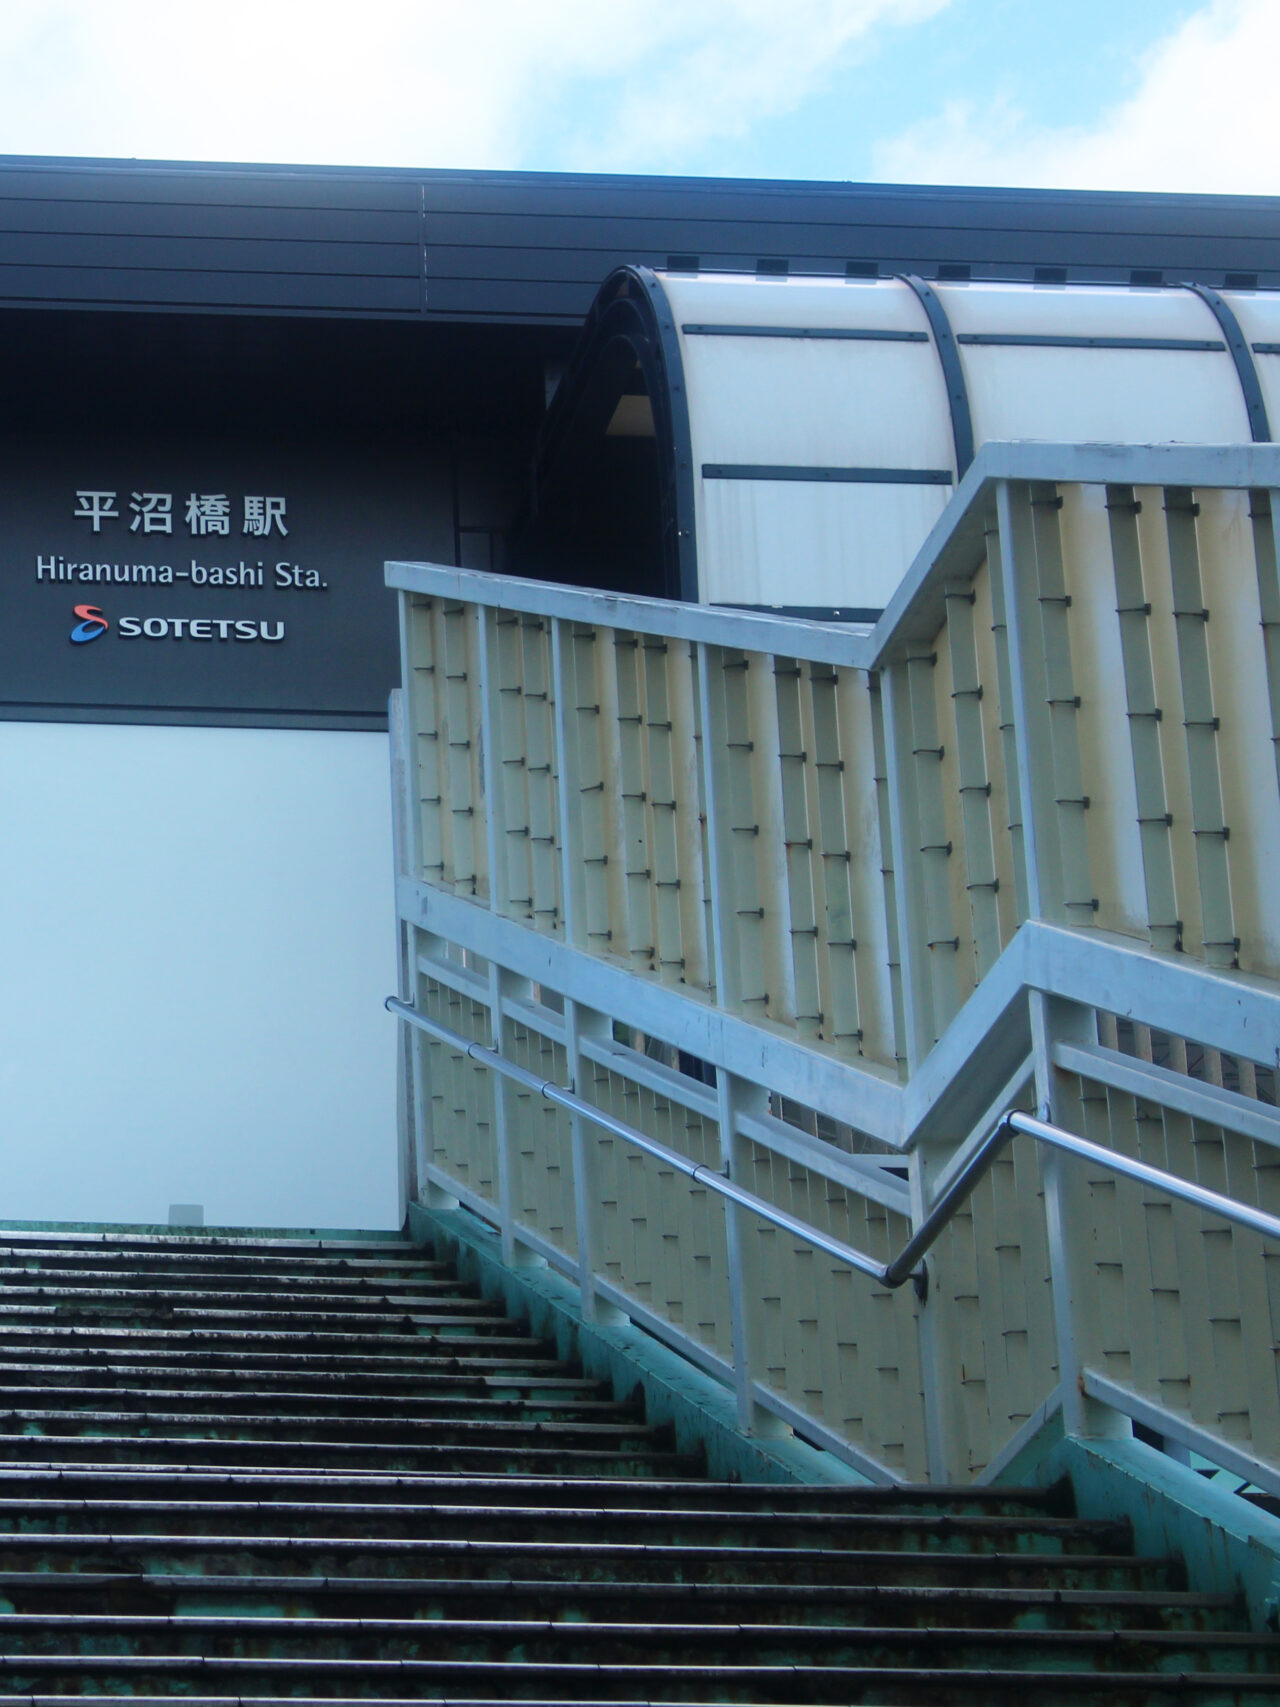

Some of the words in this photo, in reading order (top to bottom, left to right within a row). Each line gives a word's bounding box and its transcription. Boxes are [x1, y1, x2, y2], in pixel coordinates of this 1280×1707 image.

[73, 490, 289, 537] 平沼橋駅
[35, 555, 265, 587] Hiranuma-bashi
[274, 562, 328, 588] Sta.
[118, 616, 286, 641] SOTETSU
